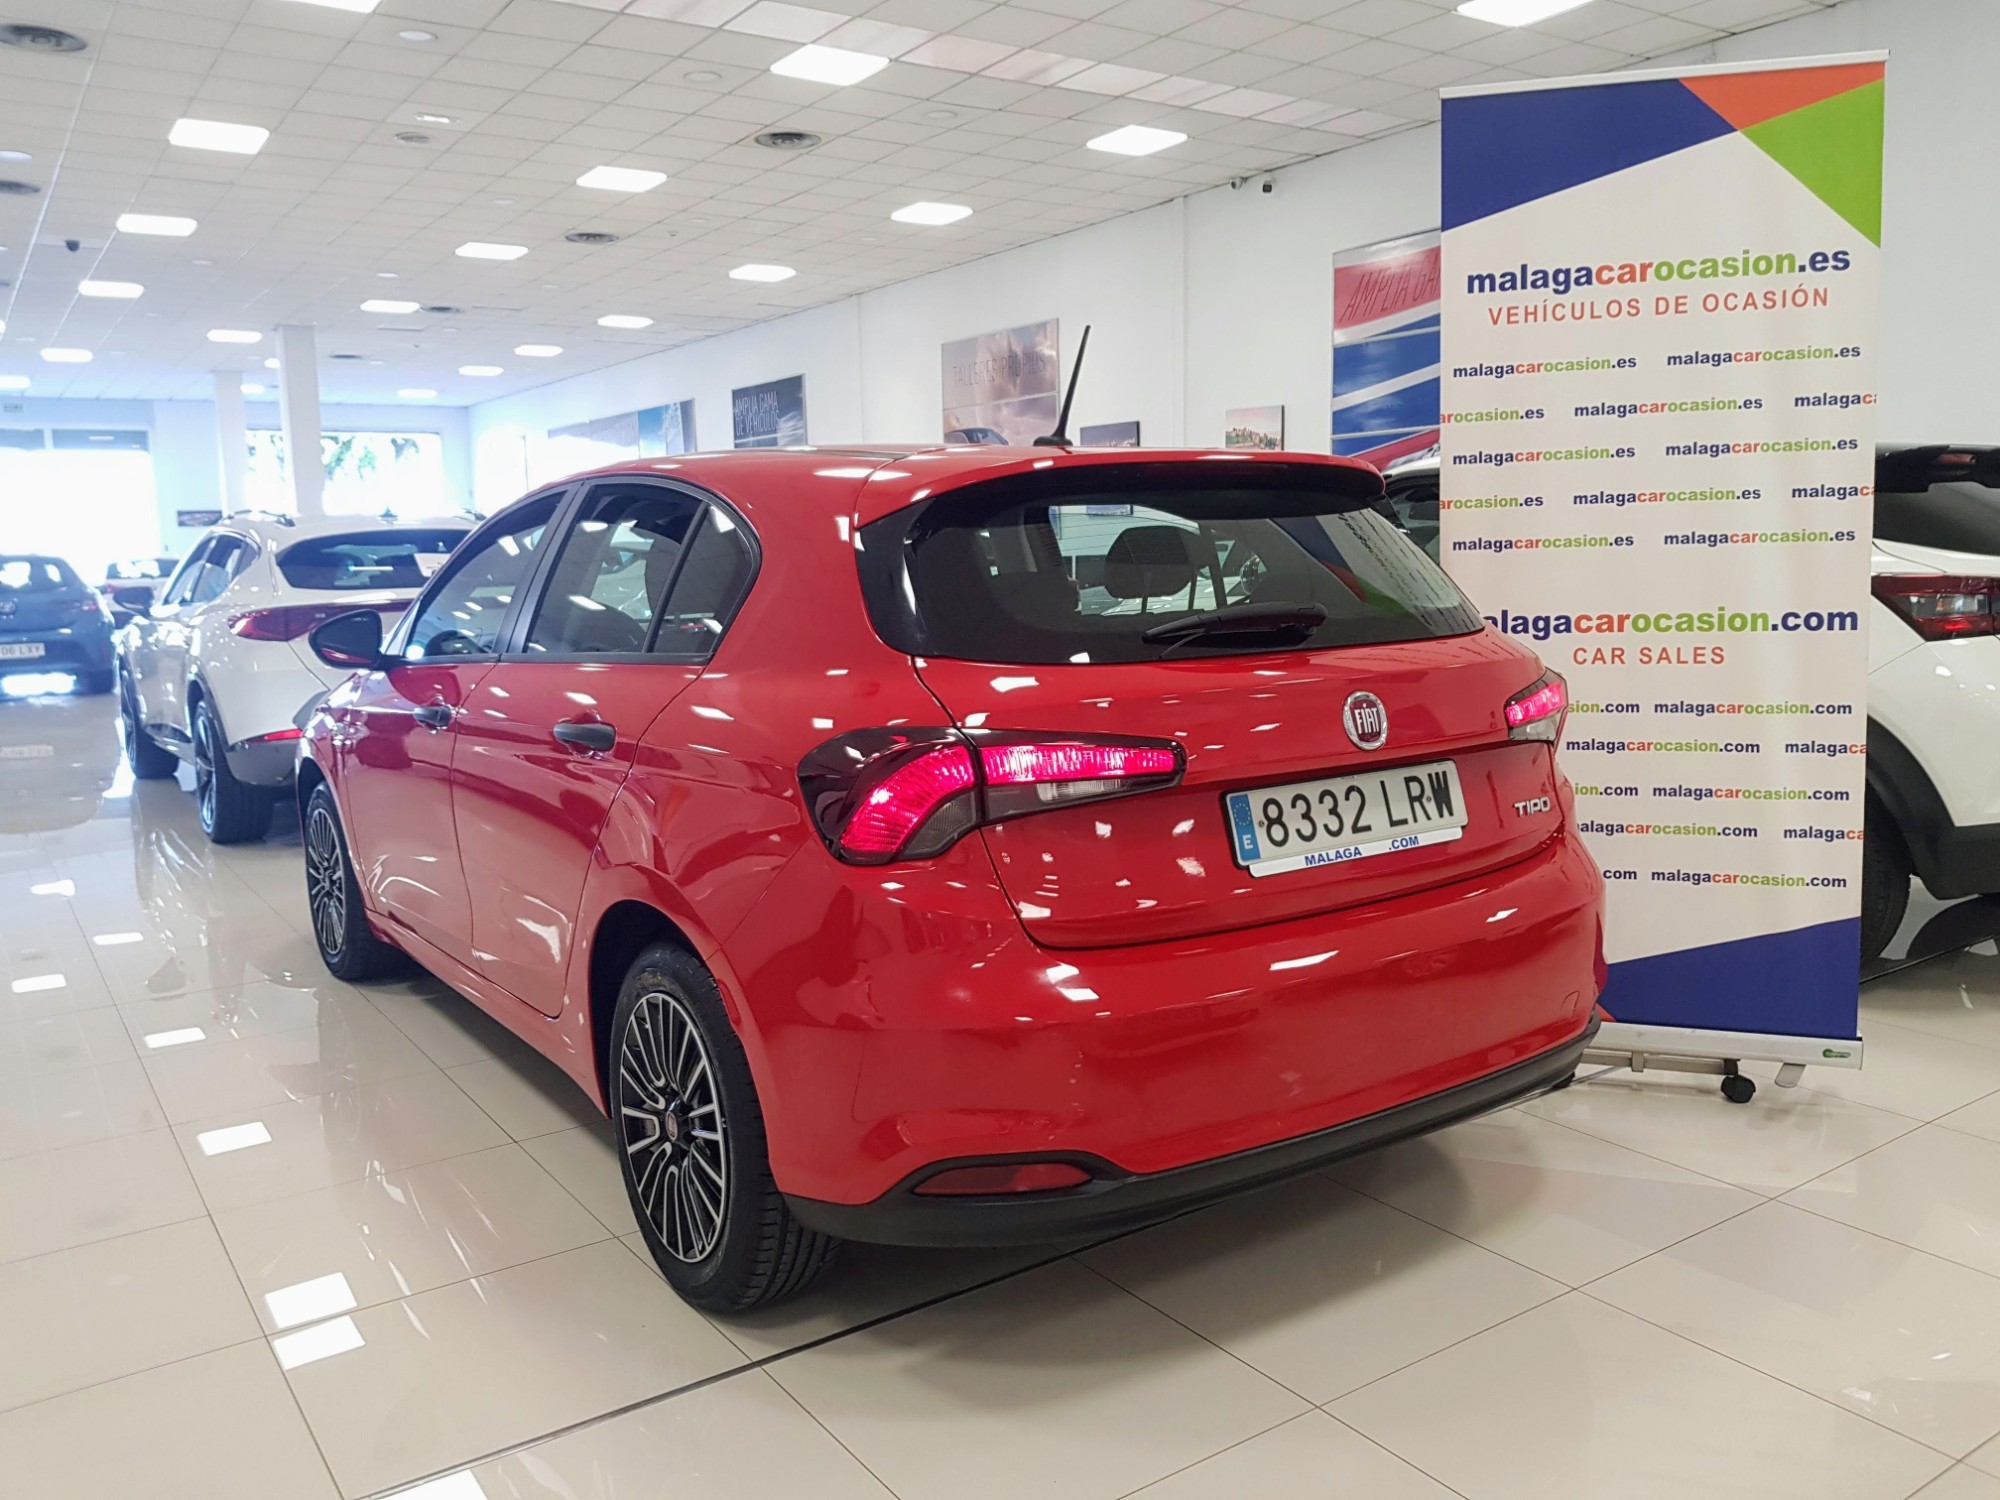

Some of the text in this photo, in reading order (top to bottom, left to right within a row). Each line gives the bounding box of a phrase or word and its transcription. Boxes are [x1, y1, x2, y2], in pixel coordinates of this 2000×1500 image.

[1466, 248, 1851, 295] malagacarocasion.es
[1487, 282, 1829, 326] VEHÍCULOS DE OCASIÓN
[1666, 344, 1861, 367] malagacarocasion.es
[1453, 356, 1638, 379] malagacarocasion.es
[1574, 396, 1764, 418] malagacarocasion.es
[1794, 392, 1877, 409] malagac
[1452, 445, 1636, 467] malagacarocasion.es
[1665, 437, 1859, 458] malagacarocasion.es
[1572, 486, 1762, 508] malagacarocasion.es
[1452, 533, 1635, 554] malagacarocasion.es
[1664, 528, 1856, 548] malagacarocasion.es
[1482, 606, 1859, 641] lagacarocasion.com
[1573, 645, 1725, 666] CAR SALES
[1353, 703, 1382, 735] FIAT
[1653, 700, 1853, 718] malagacarocasion.com
[1565, 737, 1761, 755] malagacarocasion.com
[1652, 783, 1850, 802] malagacarocasion.com
[1262, 770, 1455, 848] 8332 LRW
[1514, 795, 1551, 818] TIPO
[1577, 819, 1758, 838] alagacarocasion.com
[1242, 834, 1253, 849] E
[1304, 835, 1420, 867] MALAGA .COM
[1650, 868, 1848, 890] malagacarocasion.com
